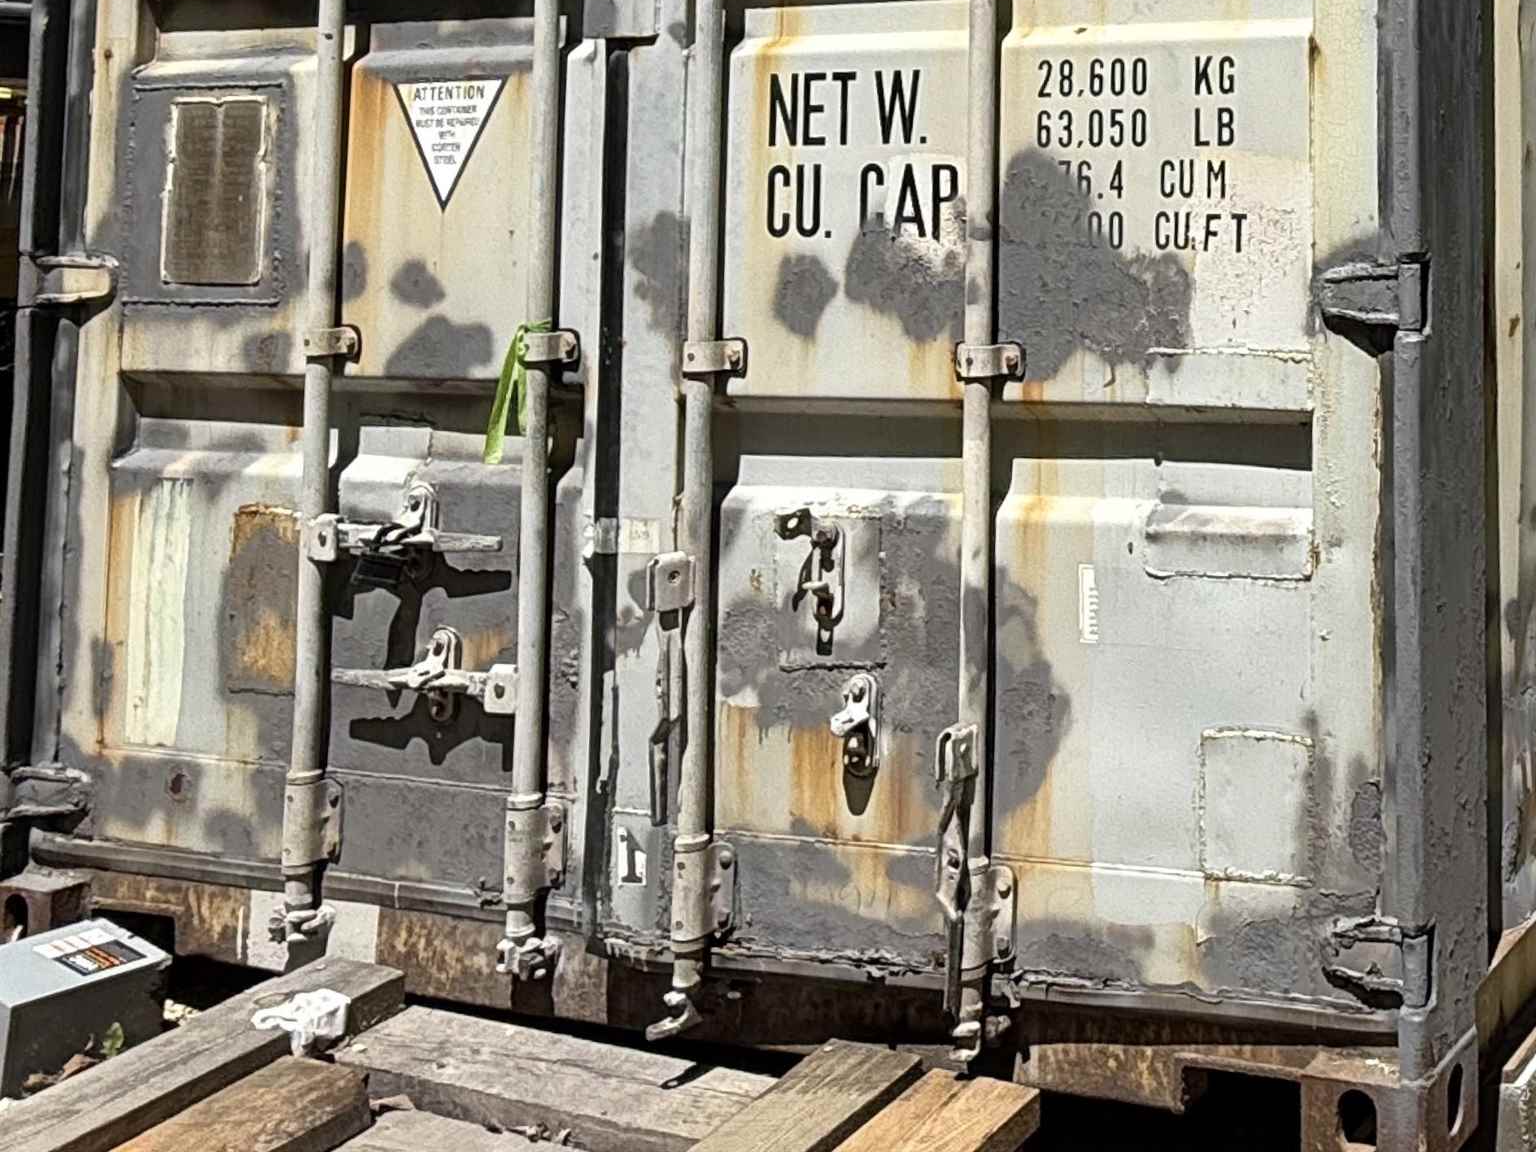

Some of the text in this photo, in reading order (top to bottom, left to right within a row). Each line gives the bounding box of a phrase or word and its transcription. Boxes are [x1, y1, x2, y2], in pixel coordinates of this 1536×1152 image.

[414, 85, 486, 101] ATTENTION
[1038, 56, 1235, 98] 28,600 KG
[768, 68, 928, 147] NET W.
[1037, 107, 1234, 148] 63,050 LB
[767, 163, 832, 239] CU.
